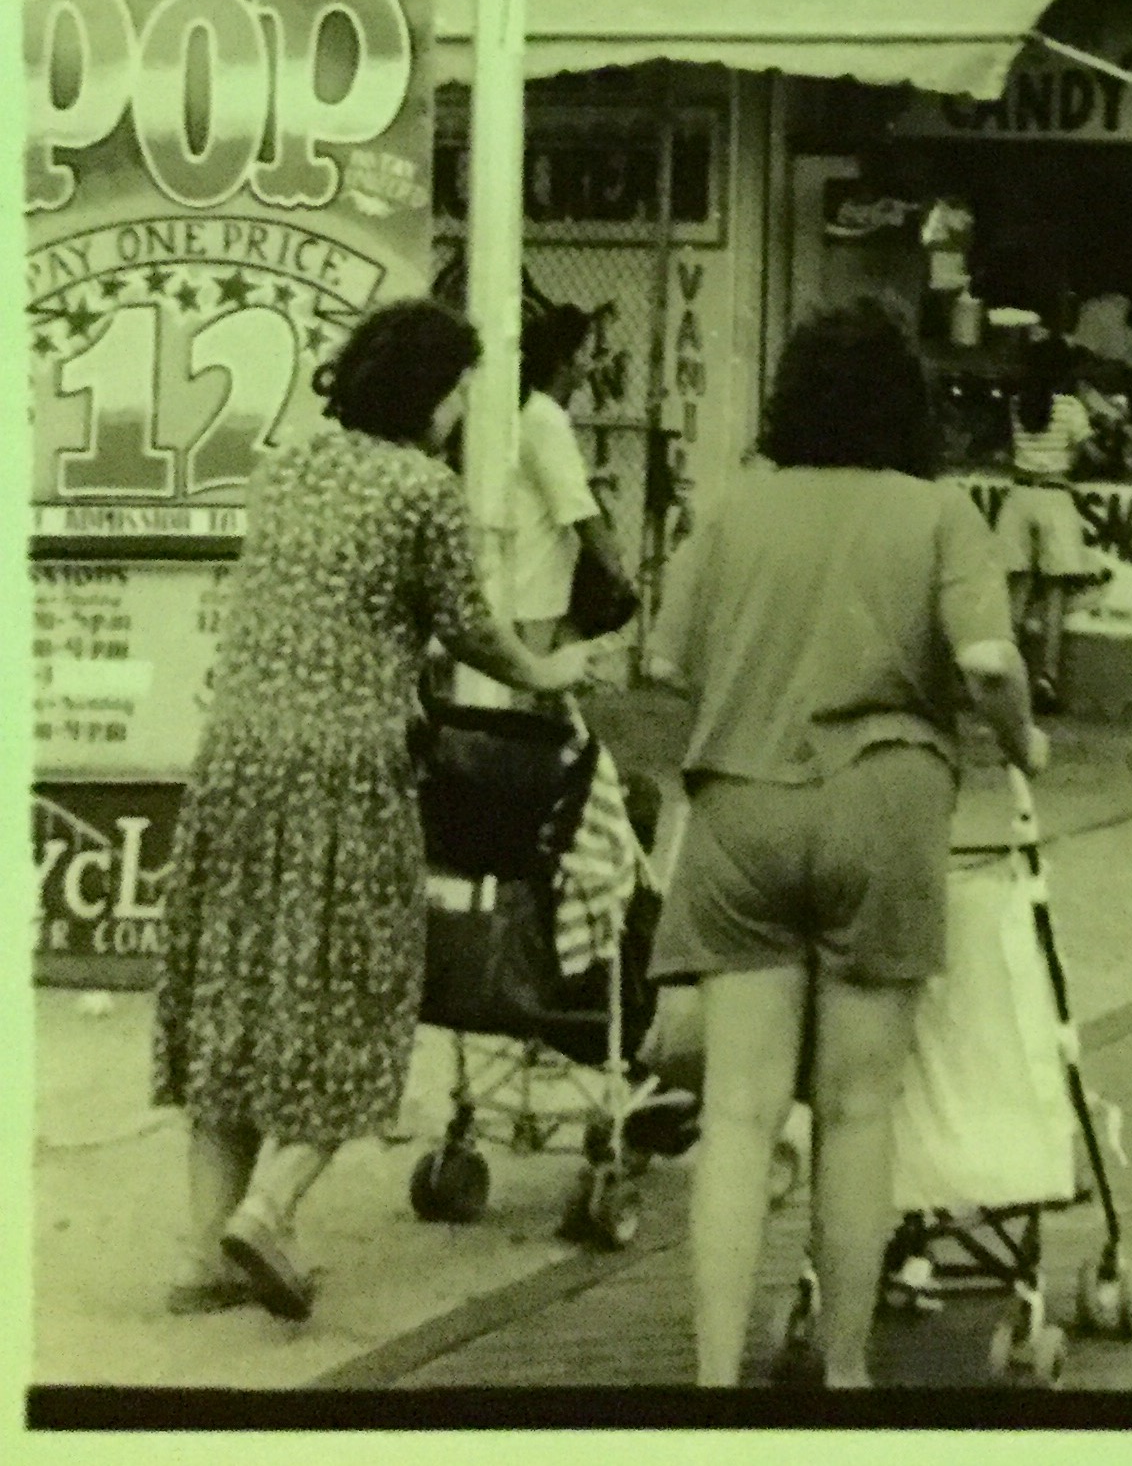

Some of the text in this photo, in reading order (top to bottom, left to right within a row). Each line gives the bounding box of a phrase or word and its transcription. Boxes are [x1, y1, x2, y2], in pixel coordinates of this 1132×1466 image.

[115, 222, 207, 263] ONE
[223, 222, 349, 288] PRICE
[54, 303, 299, 500] 12
